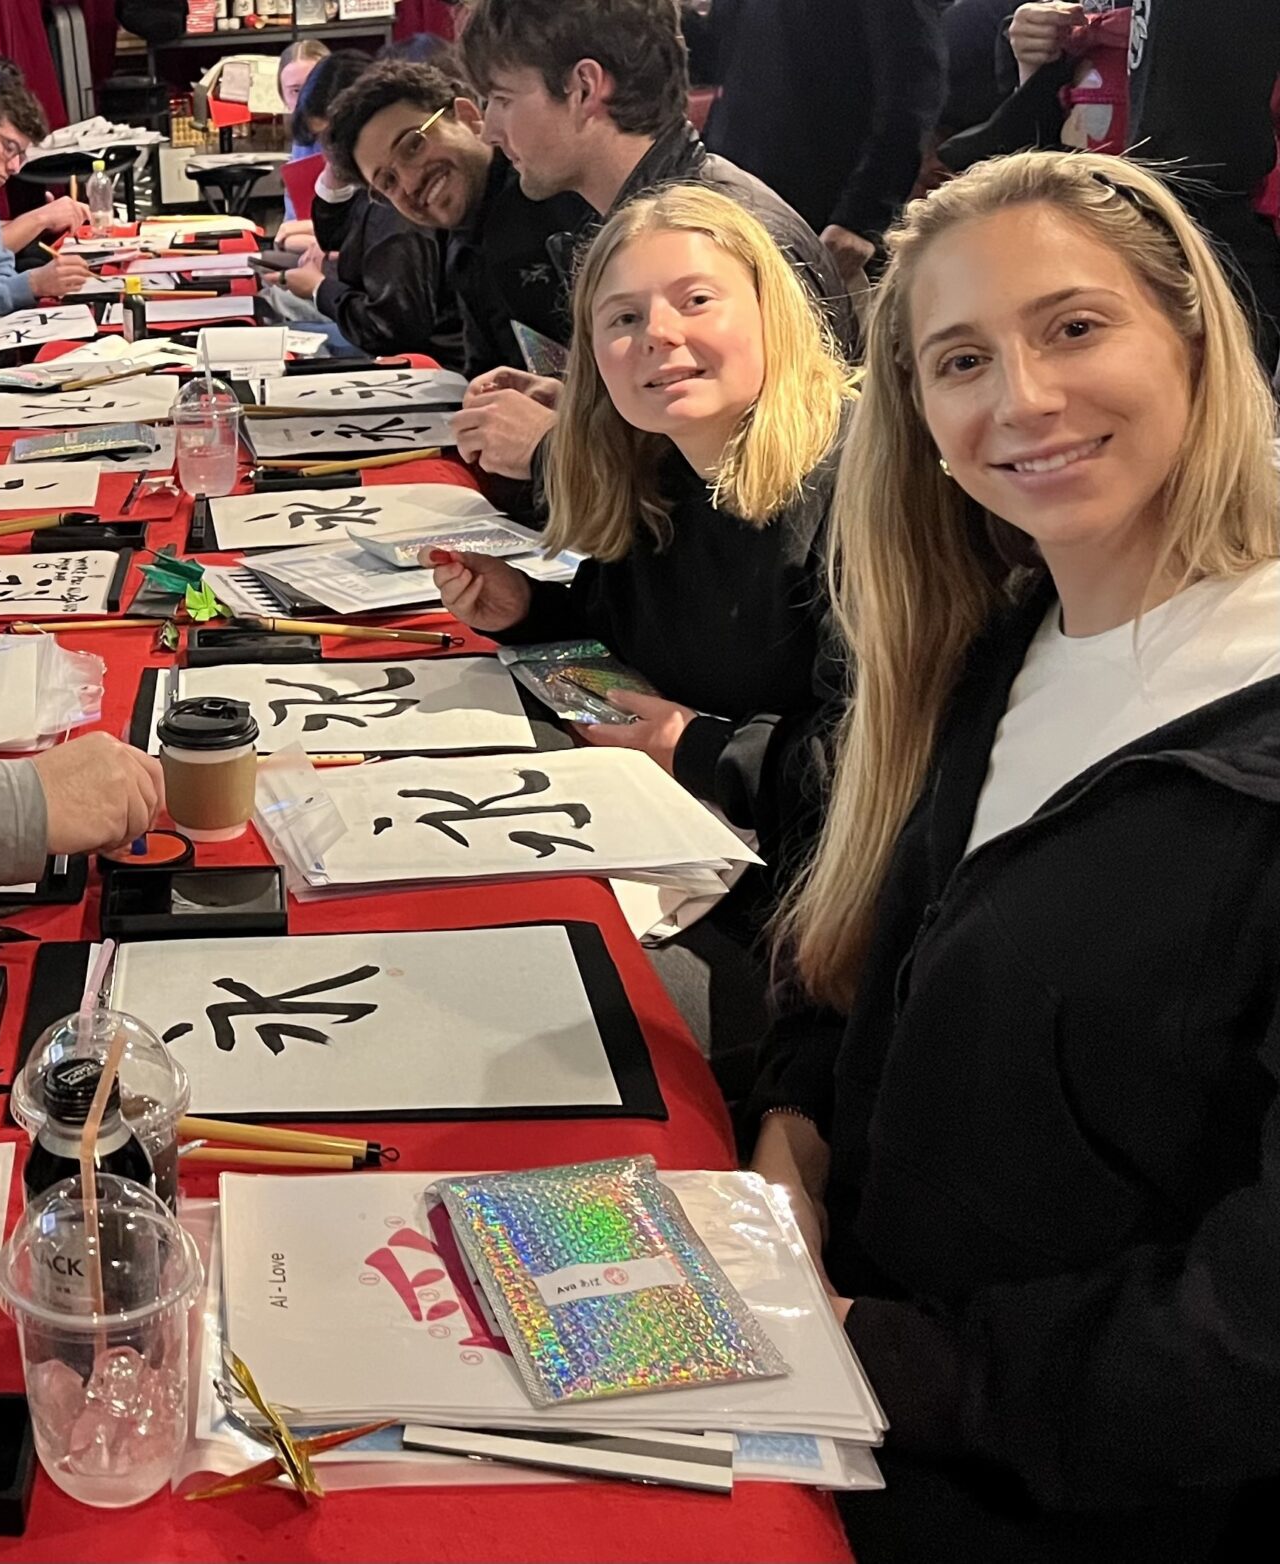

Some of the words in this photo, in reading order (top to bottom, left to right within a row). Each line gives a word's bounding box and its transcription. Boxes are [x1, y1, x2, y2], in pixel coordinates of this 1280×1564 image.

[268, 1252, 287, 1285] Love
[557, 1283, 577, 1294] Ava
[270, 1296, 289, 1309] Ai
